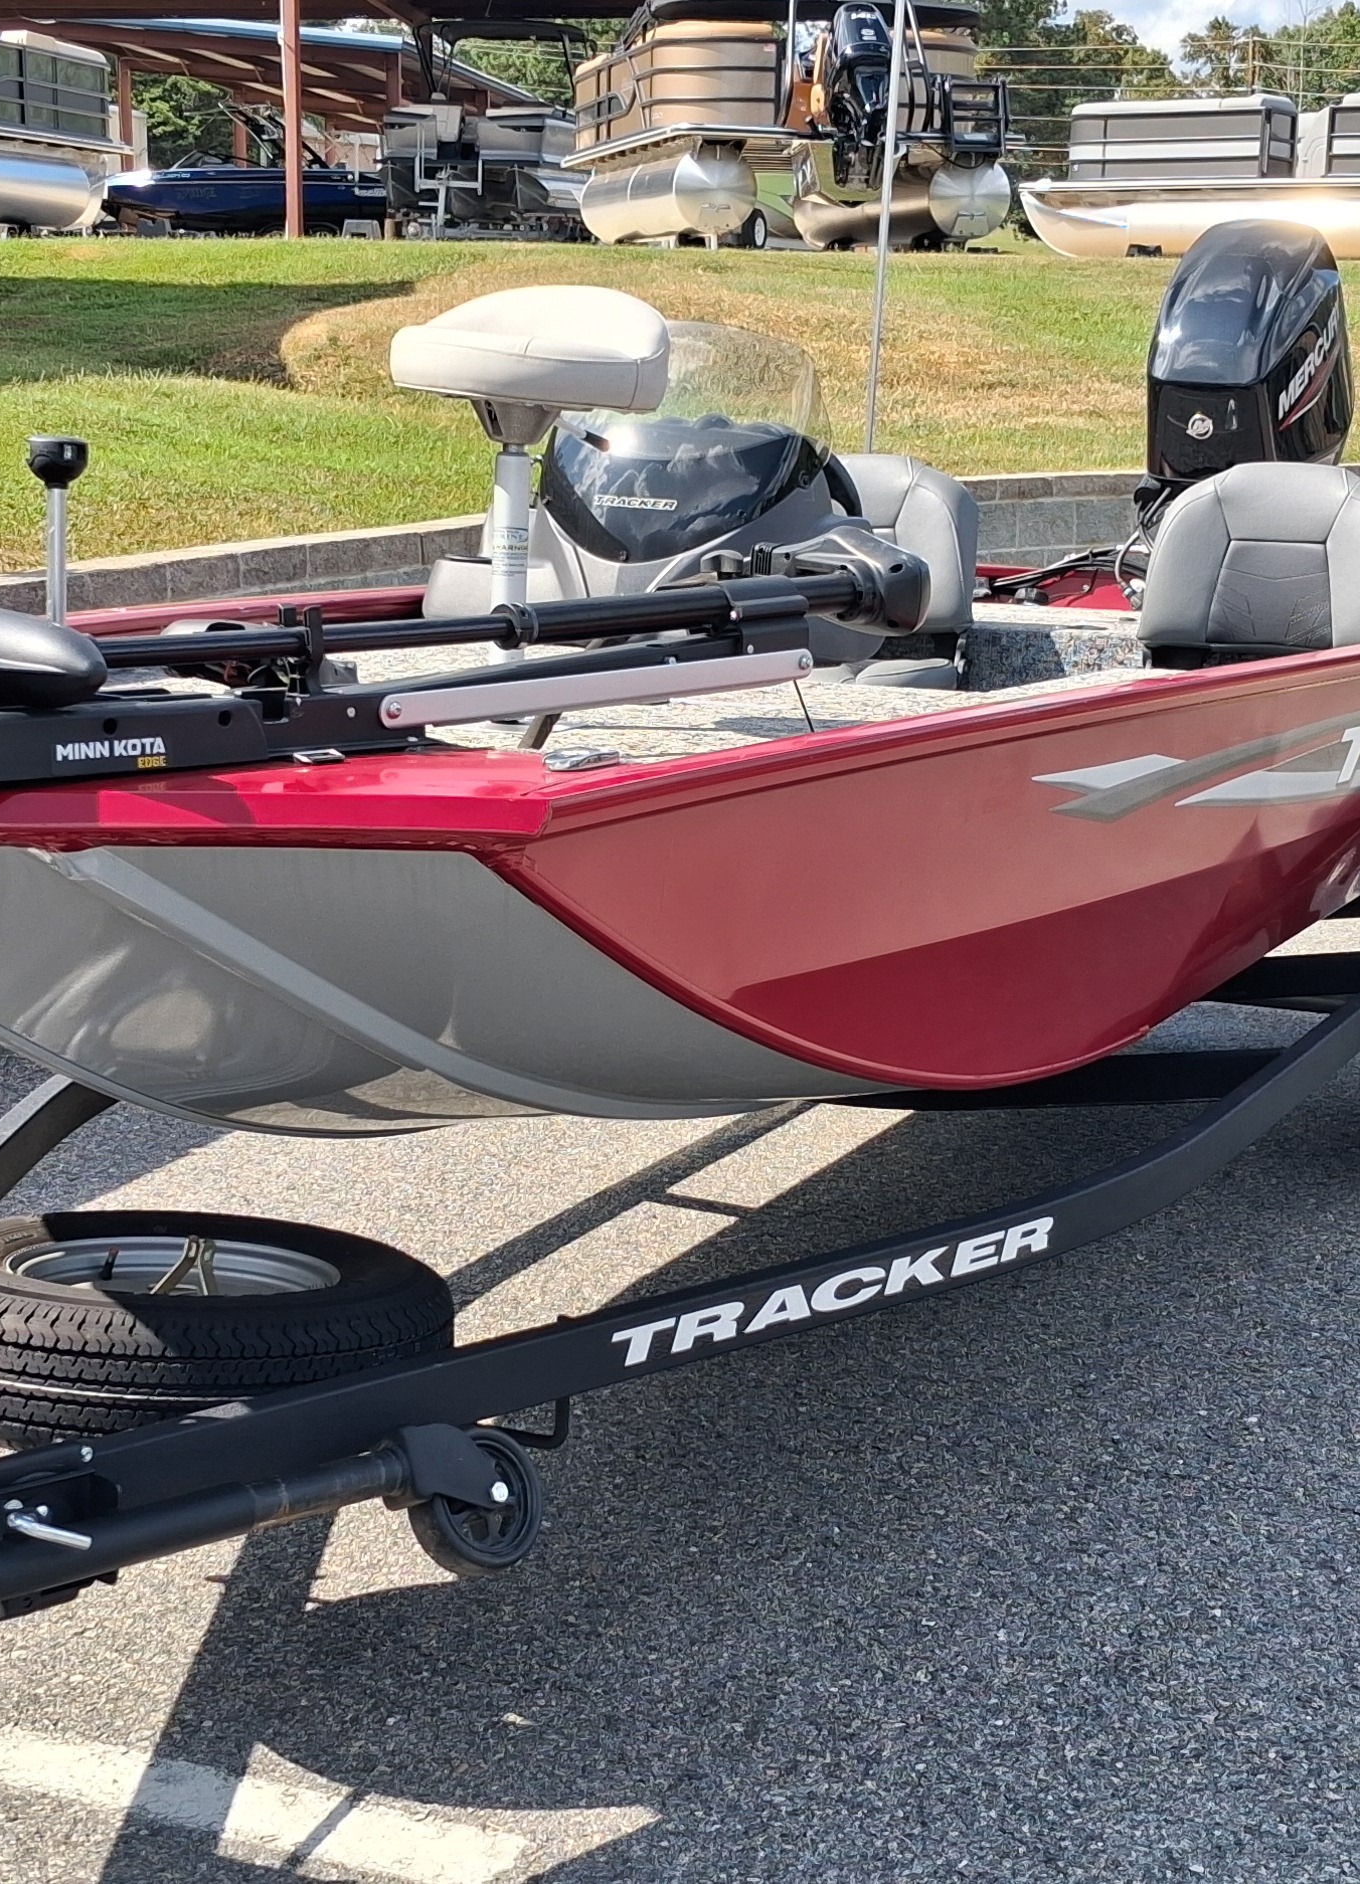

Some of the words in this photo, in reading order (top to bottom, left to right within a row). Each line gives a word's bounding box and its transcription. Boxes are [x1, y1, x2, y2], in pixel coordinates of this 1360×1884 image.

[595, 494, 678, 511] TRACKER
[55, 740, 110, 761] MINN
[113, 737, 167, 757] KOTA
[611, 1216, 1055, 1367] TRACKER
